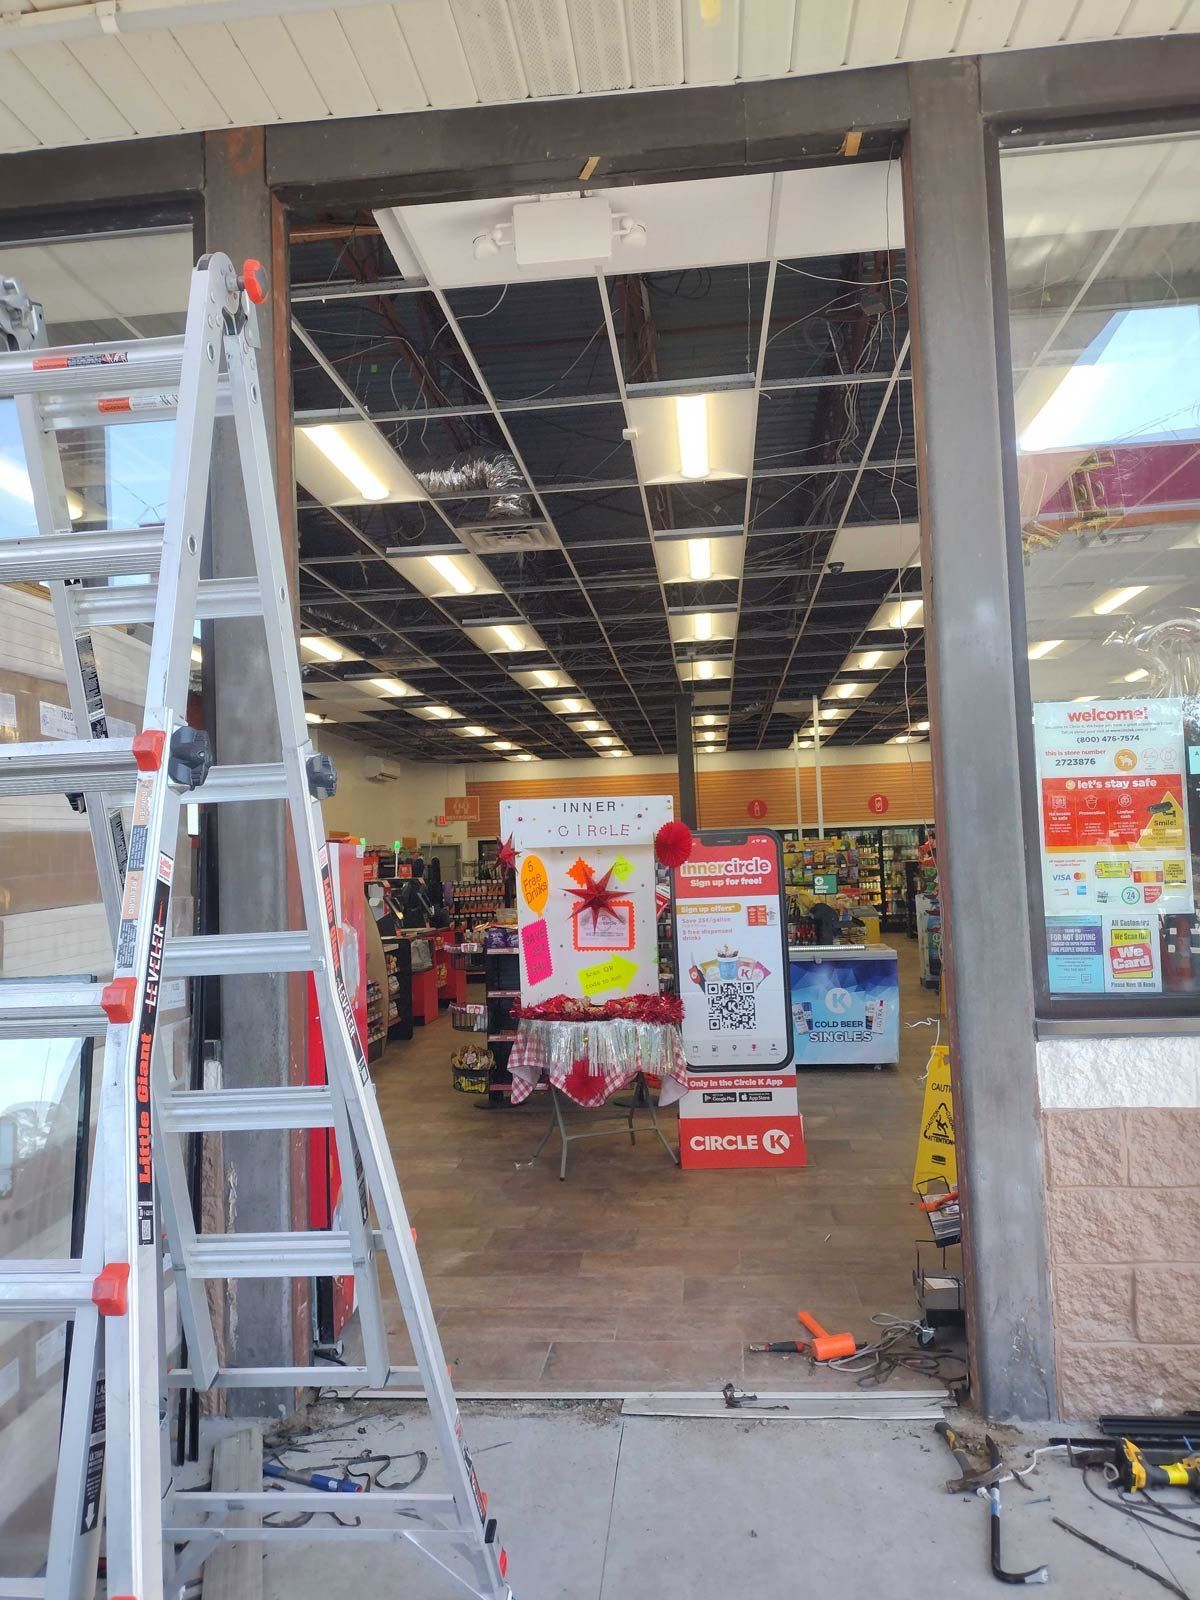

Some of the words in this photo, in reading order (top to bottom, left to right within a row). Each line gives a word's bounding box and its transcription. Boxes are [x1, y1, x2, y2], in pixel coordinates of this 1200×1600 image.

[1067, 706, 1149, 723] welcome!
[1076, 736, 1100, 744] (800)
[1101, 735, 1140, 743] 476-7574
[1055, 758, 1096, 767] 2723876
[1077, 779, 1102, 789] let's
[1104, 778, 1129, 790] stay
[1132, 777, 1157, 788] safe
[563, 800, 616, 813] INNER
[1153, 819, 1177, 827] Smile!
[527, 860, 534, 872] 5
[681, 858, 770, 876] innercircle
[690, 879, 711, 888] Sign
[712, 879, 725, 887] up
[725, 877, 740, 885] for
[740, 876, 762, 885] free!
[1126, 891, 1136, 900] 24
[681, 906, 698, 914] Sign
[1117, 944, 1144, 958] We
[145, 923, 165, 1008] LEVELER
[1112, 954, 1151, 970] Card
[814, 1020, 839, 1028] COLD
[840, 1020, 864, 1028] BEER
[809, 1031, 873, 1043] SINGLES
[136, 1031, 152, 1103] Giant
[689, 1080, 709, 1088] Only
[709, 1079, 718, 1087] in
[718, 1079, 733, 1087] the
[733, 1078, 756, 1086] Circle
[765, 1078, 783, 1087] App
[138, 1111, 152, 1184] Little
[689, 1135, 759, 1151] CIRCLE
